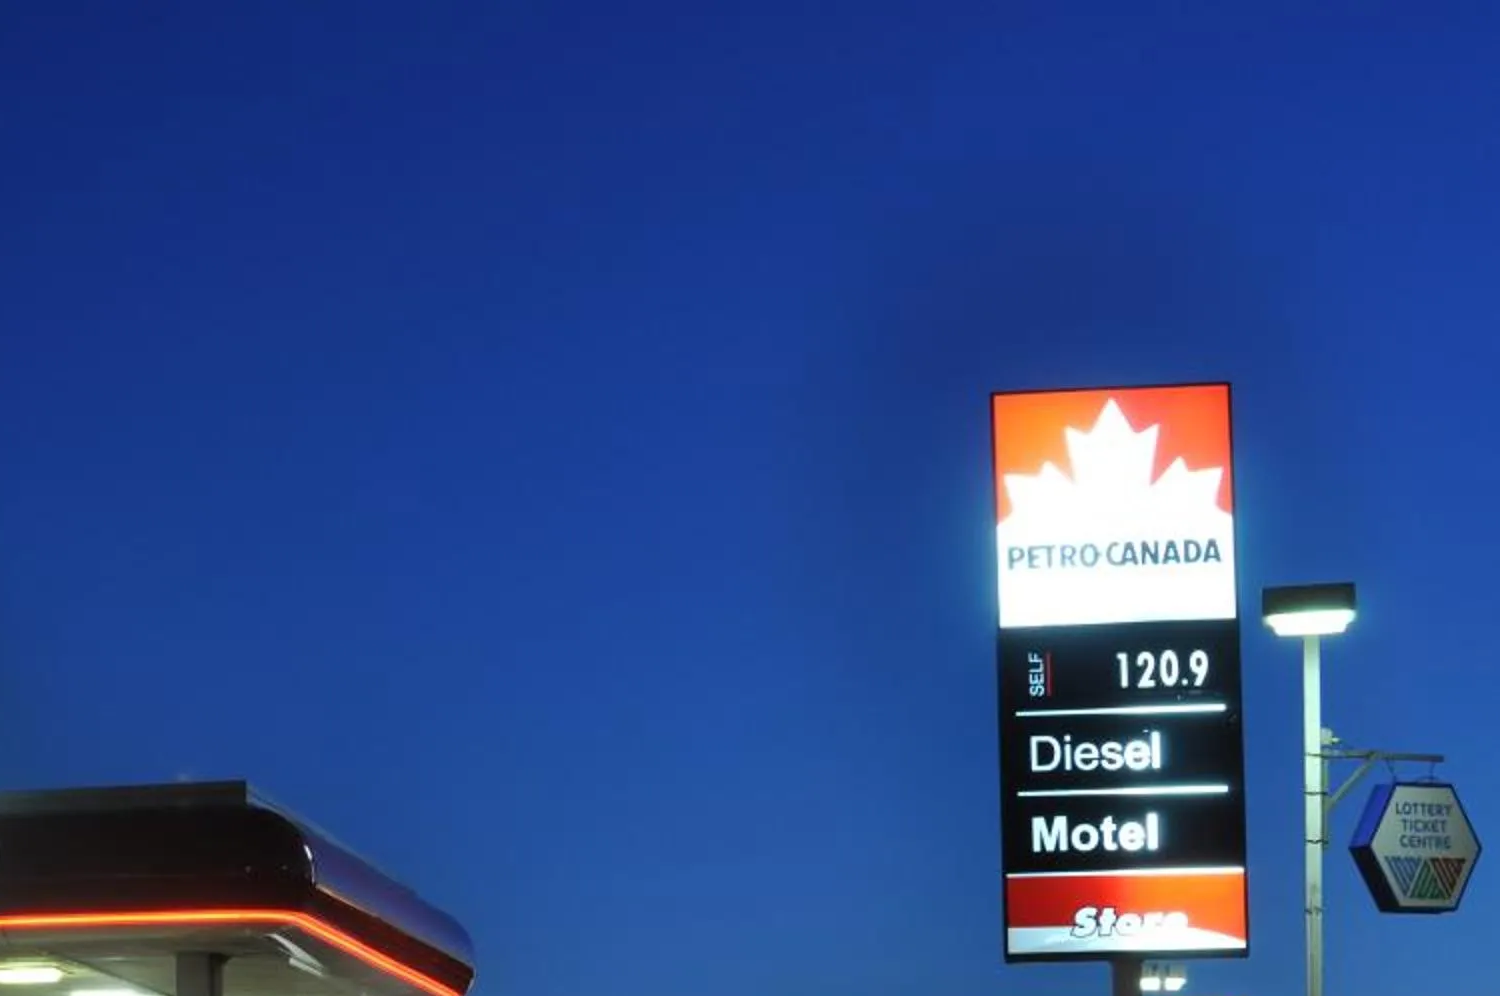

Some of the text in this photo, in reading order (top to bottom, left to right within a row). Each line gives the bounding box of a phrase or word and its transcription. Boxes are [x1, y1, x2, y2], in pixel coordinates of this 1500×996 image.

[1027, 652, 1045, 697] SELF
[1116, 649, 1209, 689] 120.9
[1029, 730, 1162, 772] Diesel
[1395, 801, 1452, 817] LOTTERY
[1401, 818, 1446, 834] TICKET
[1031, 812, 1160, 853] Motel
[1399, 834, 1451, 849] CENTRE
